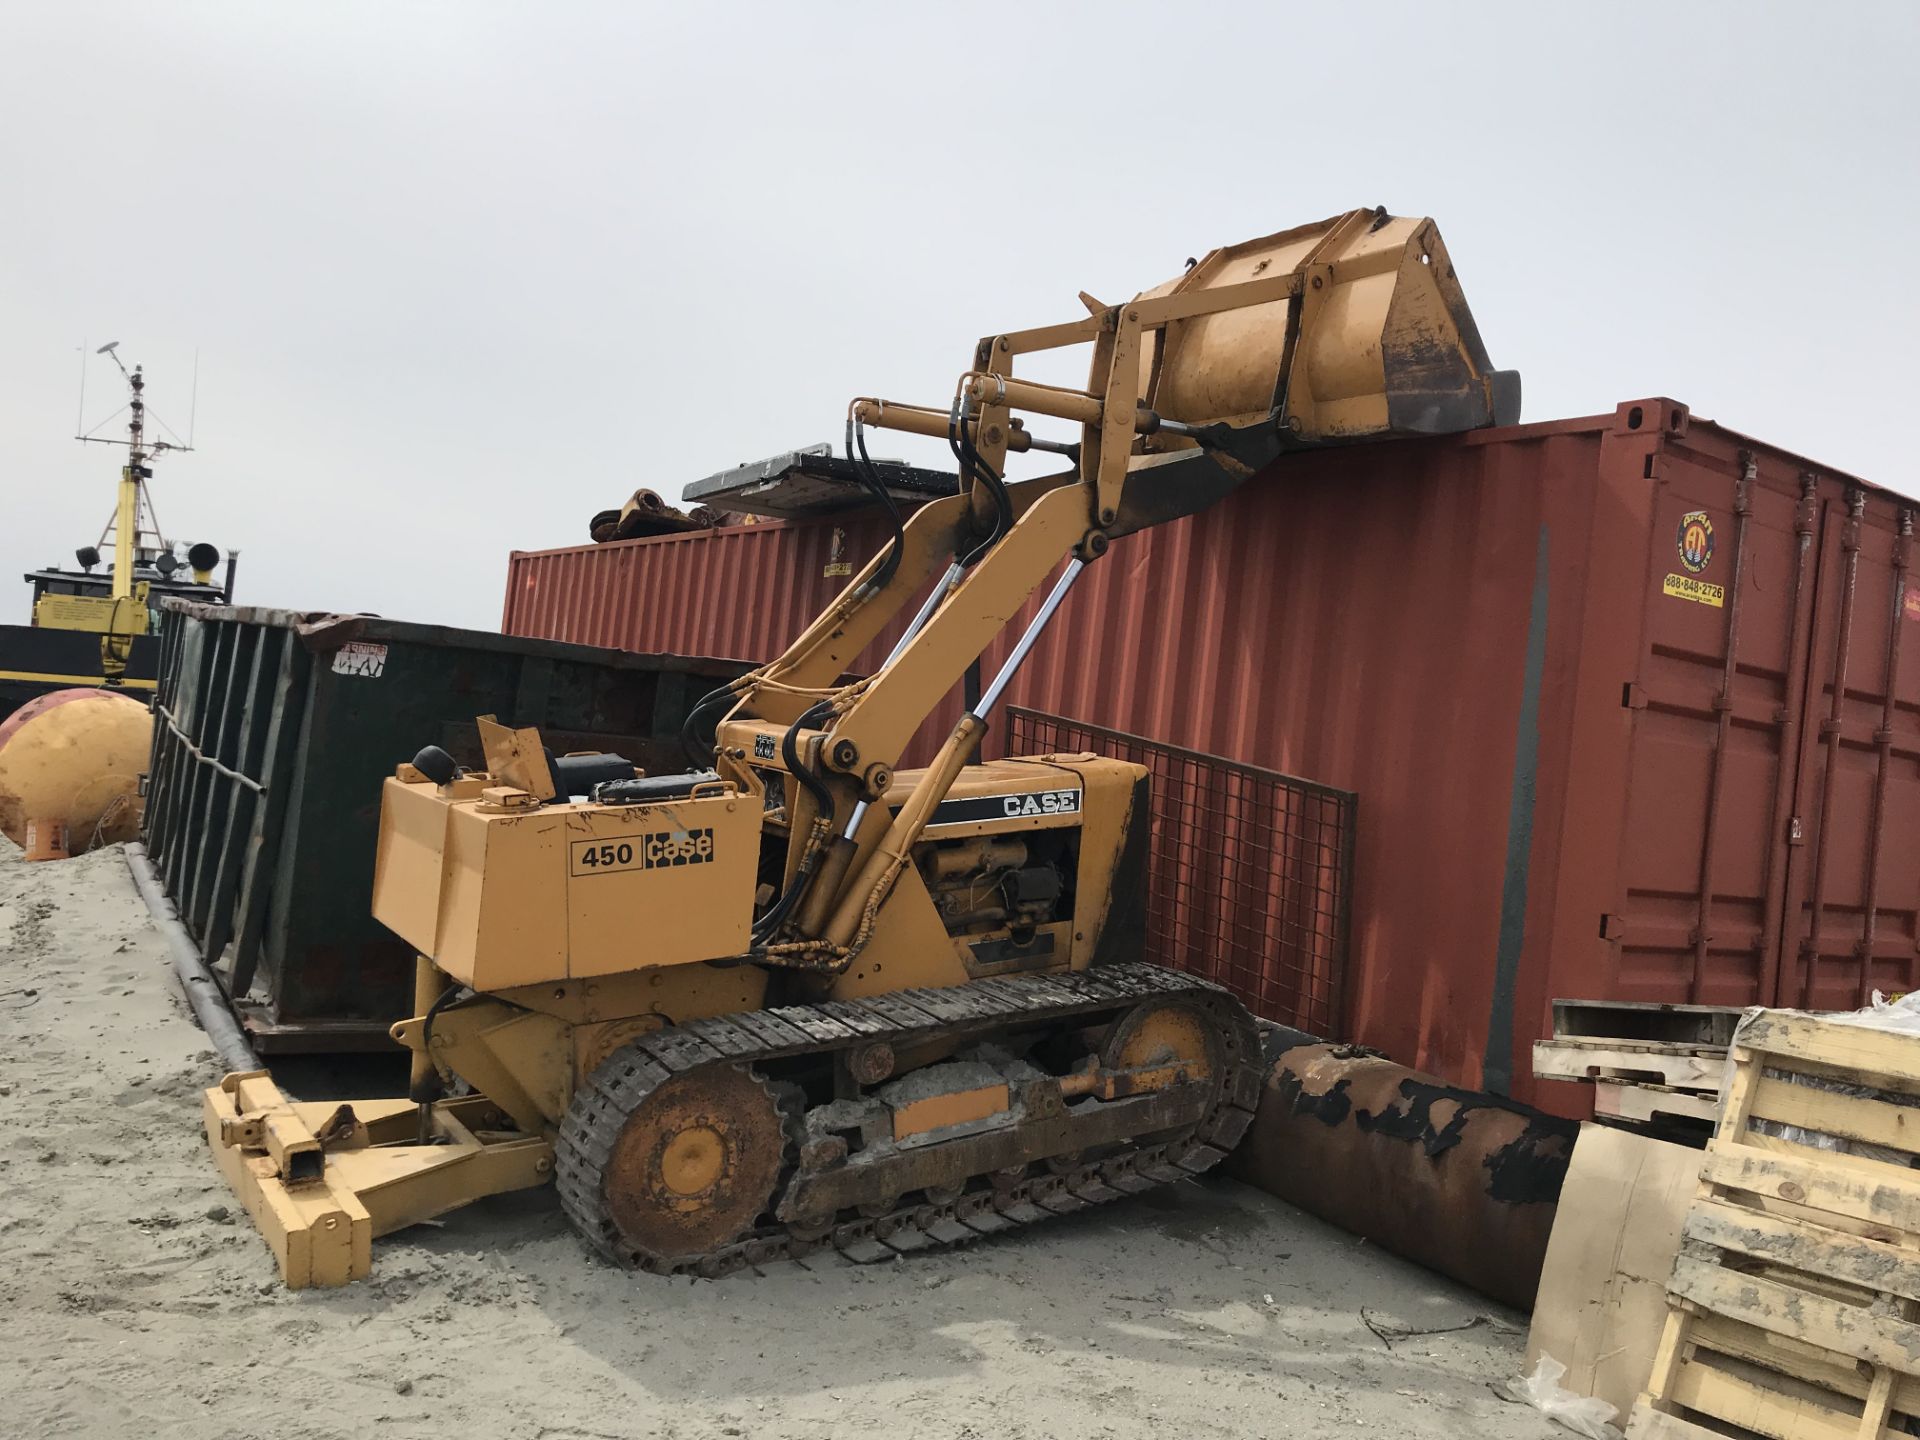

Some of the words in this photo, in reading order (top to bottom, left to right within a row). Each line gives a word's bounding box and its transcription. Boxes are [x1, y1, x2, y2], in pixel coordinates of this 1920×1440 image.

[341, 643, 386, 657] ARNING
[1003, 792, 1075, 816] CASE
[582, 843, 633, 868] 450
[646, 833, 713, 865] case
